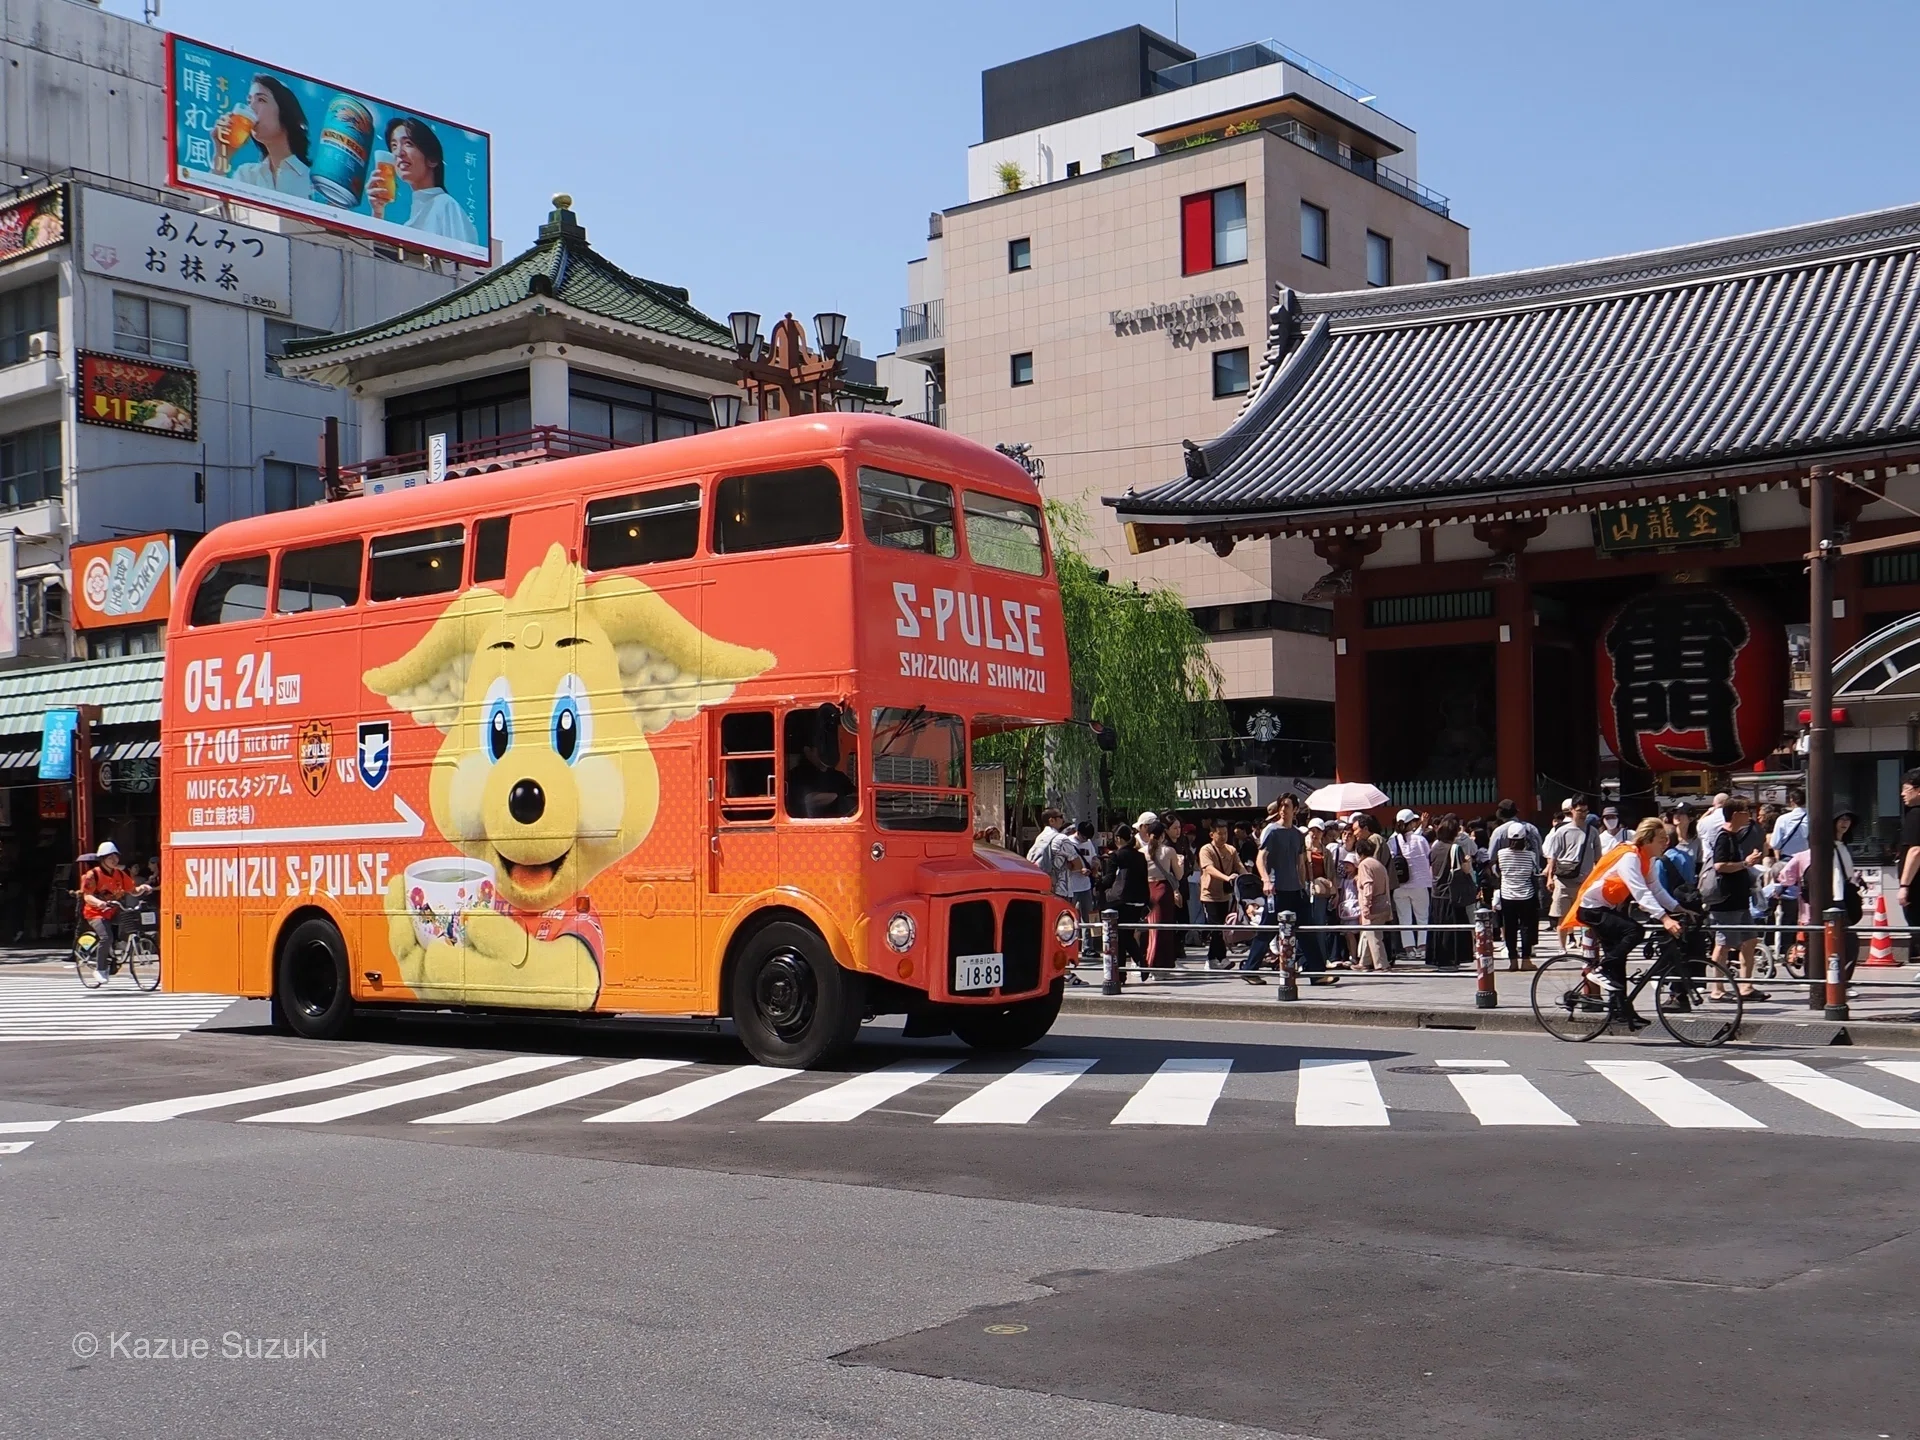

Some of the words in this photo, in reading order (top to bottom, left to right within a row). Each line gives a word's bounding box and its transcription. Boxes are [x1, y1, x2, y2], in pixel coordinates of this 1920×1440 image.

[183, 67, 215, 170] 晴れ風
[156, 212, 265, 258] あんみつ
[145, 246, 239, 291] お抹茶
[1108, 290, 1237, 325] Kaminarimon
[1165, 312, 1238, 338] Ryokan
[111, 398, 138, 422] 1F
[892, 581, 1045, 657] S-PULSE
[184, 651, 274, 713] 05.24
[277, 678, 299, 701] SUN
[899, 652, 979, 684] SHIZUOKA
[987, 662, 1046, 694] SHIMIZU
[184, 729, 240, 766] 17:00
[244, 735, 268, 753] KICK
[270, 733, 290, 751] OFF
[301, 743, 331, 758] S-PULSE
[186, 773, 293, 801] MUFGスタジアム
[335, 758, 356, 783] VS
[1176, 786, 1248, 802] TARBUCKS
[187, 805, 256, 827] (国立競技場)
[185, 856, 277, 897] SHIMIZU
[285, 852, 390, 897] S-PULSE
[966, 964, 1001, 987] 18-89
